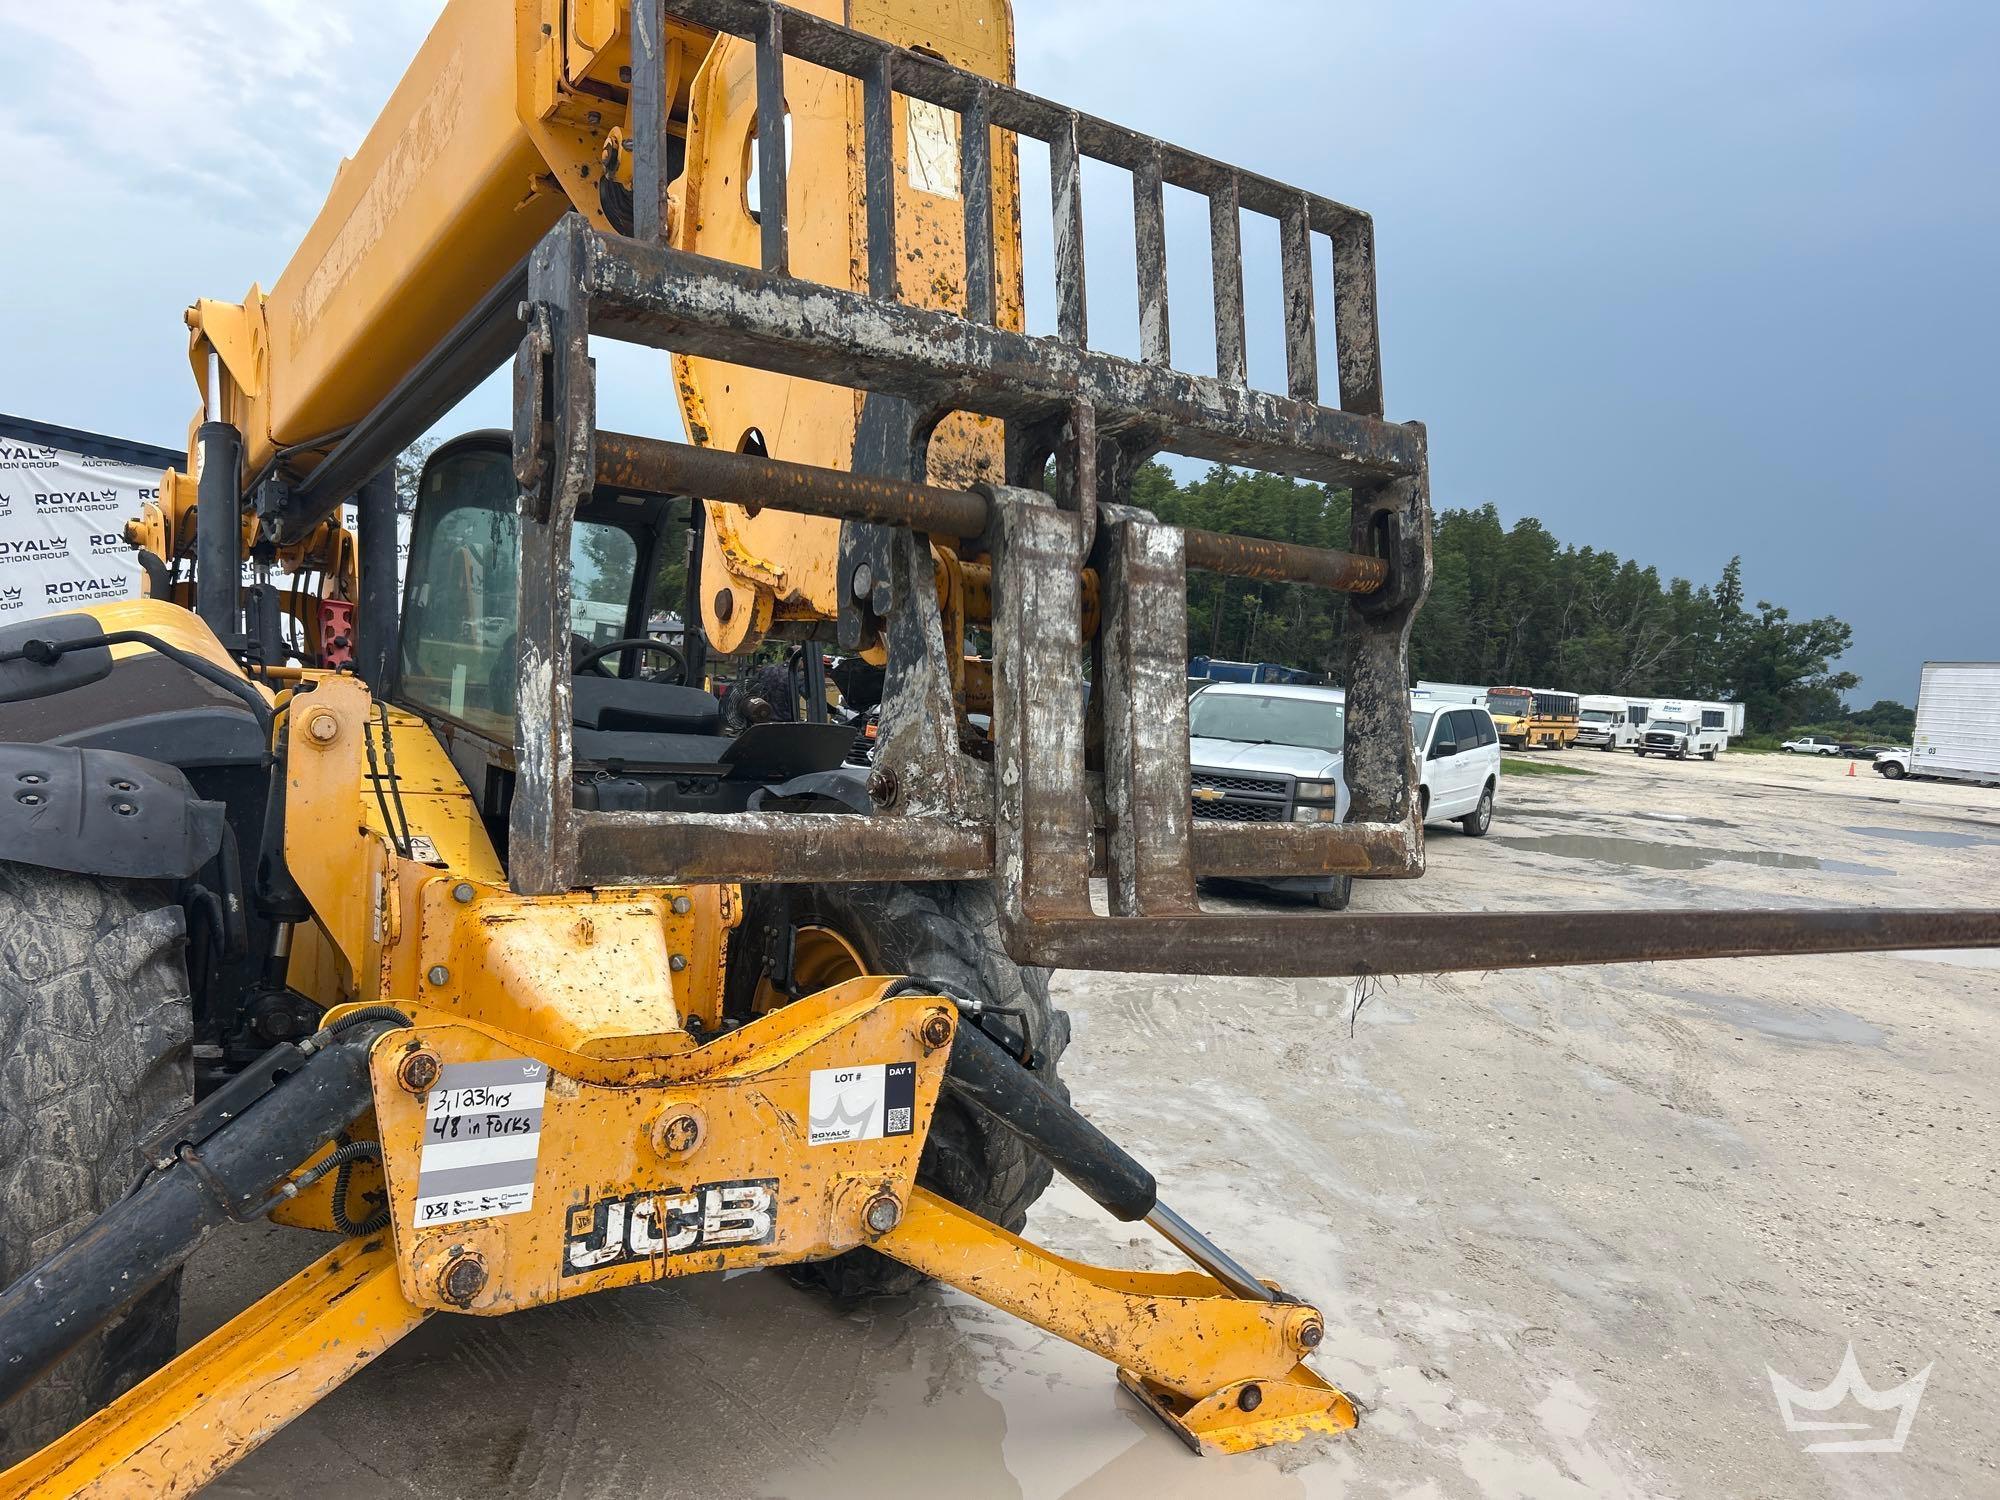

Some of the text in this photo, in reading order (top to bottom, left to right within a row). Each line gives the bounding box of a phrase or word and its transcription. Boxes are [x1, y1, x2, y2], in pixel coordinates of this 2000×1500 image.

[21, 461, 59, 469] GROUP
[35, 491, 101, 505] ROYAL
[37, 503, 119, 514] AUCTION GROUP
[33, 551, 70, 561] GROUP
[45, 578, 110, 595] ROYAL
[47, 588, 129, 604] AUCTION GROUP
[889, 1068, 906, 1076] DAY
[834, 1073, 854, 1083] LOT
[433, 1115, 461, 1139] 48
[468, 1119, 480, 1134] in
[811, 1130, 842, 1139] ROYAL
[570, 1186, 771, 1268] JCB
